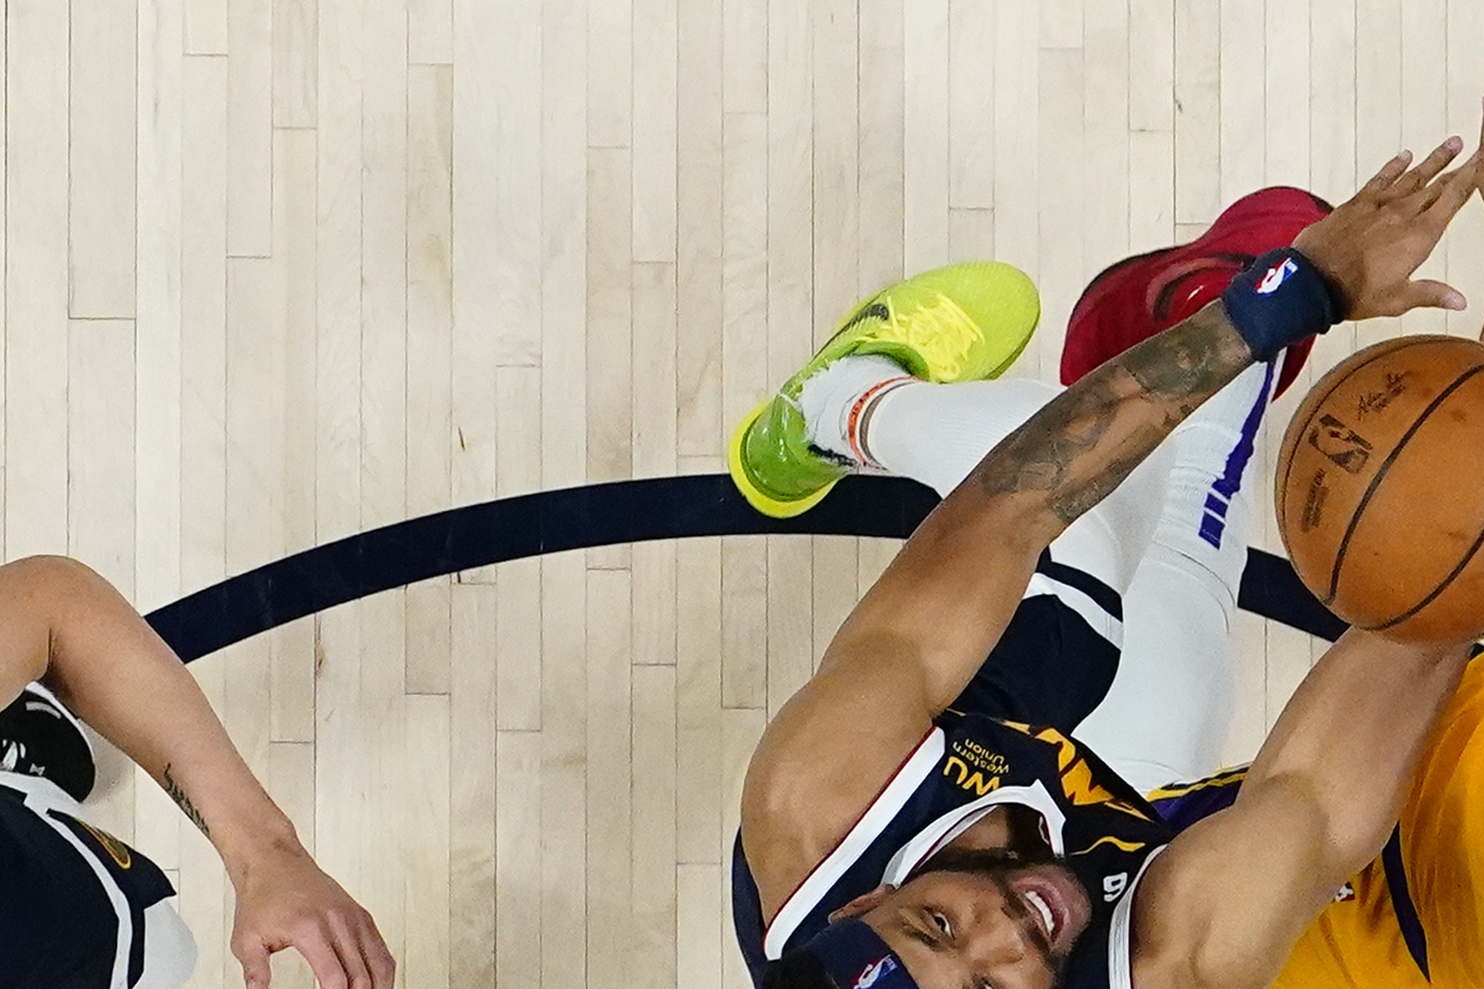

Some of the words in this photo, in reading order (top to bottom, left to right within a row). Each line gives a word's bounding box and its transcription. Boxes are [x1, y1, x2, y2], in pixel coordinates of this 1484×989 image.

[951, 740, 1009, 776] Western
[964, 738, 1004, 764] Union
[943, 755, 1000, 797] WU
